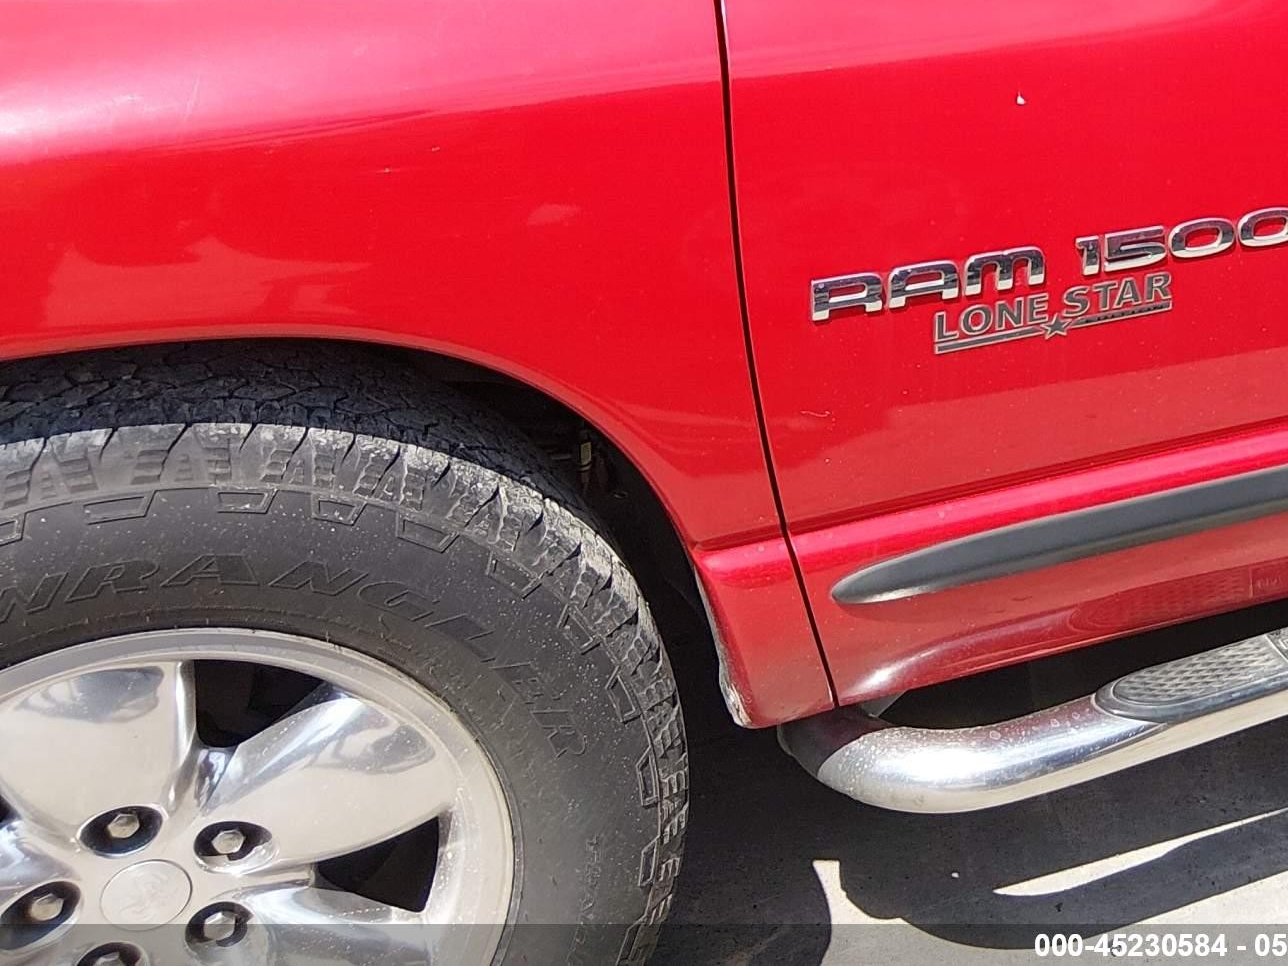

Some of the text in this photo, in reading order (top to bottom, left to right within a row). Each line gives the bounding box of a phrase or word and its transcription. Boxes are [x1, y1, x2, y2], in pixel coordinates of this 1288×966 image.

[811, 246, 1046, 322] RAM
[933, 292, 1049, 342] LONE
[1062, 271, 1172, 318] STAR
